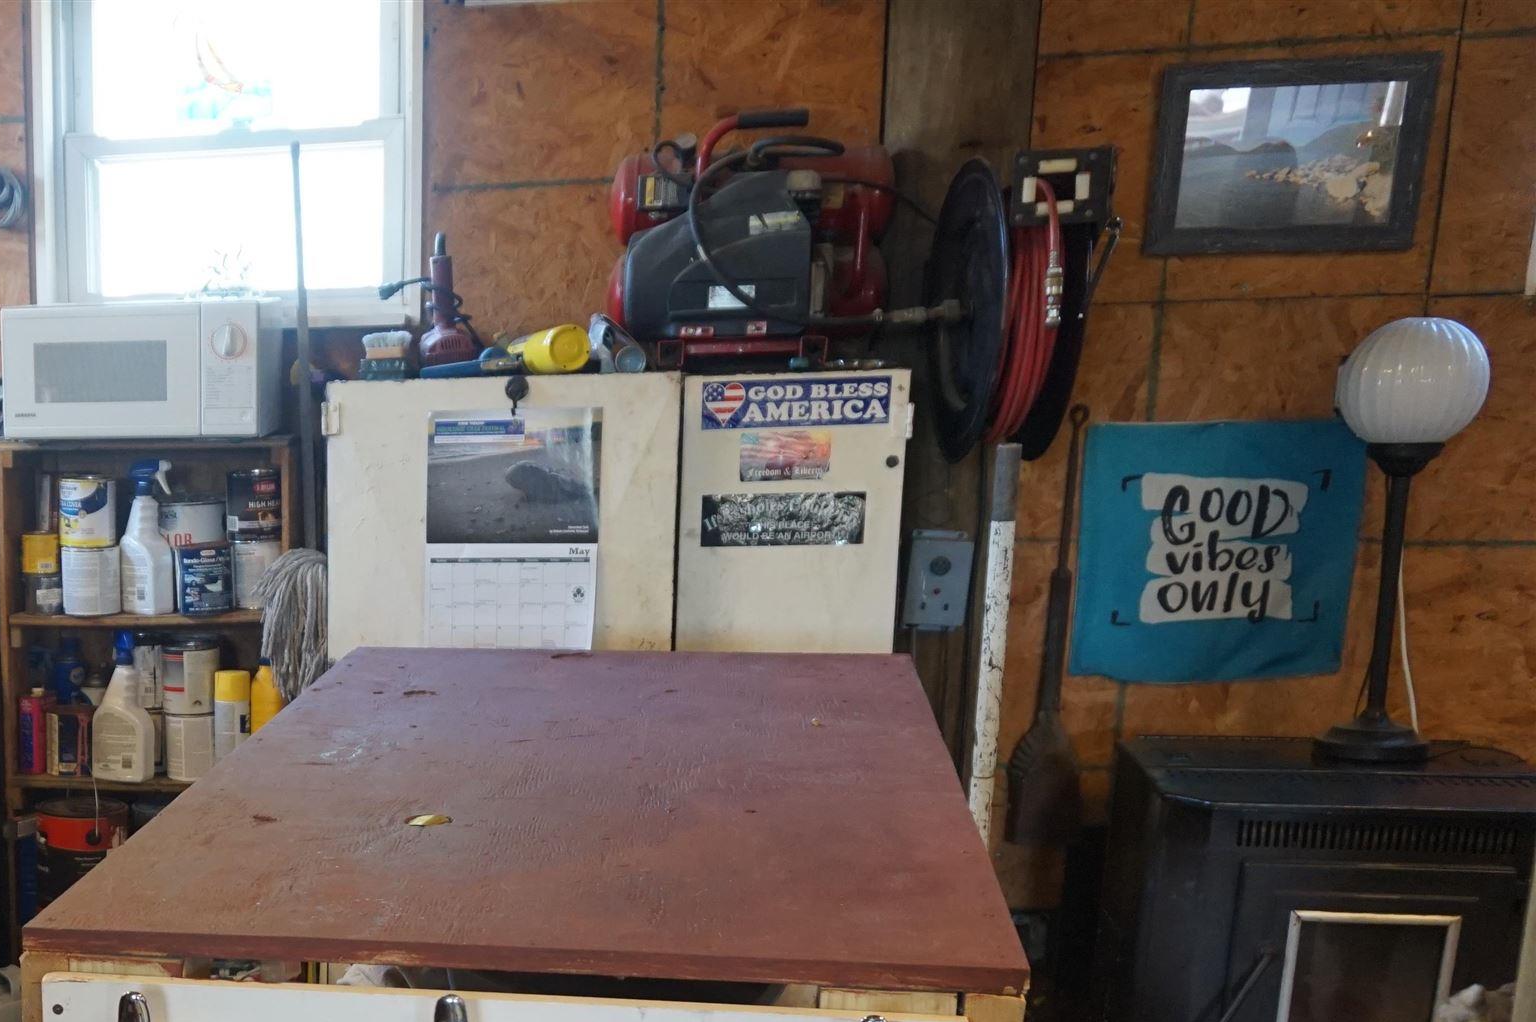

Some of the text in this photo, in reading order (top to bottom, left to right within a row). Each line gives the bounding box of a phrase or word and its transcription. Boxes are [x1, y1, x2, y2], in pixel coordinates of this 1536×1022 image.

[748, 381, 889, 400] GOD BLESS
[742, 399, 886, 422] AMERICA
[1161, 484, 1291, 545] GOOD
[724, 530, 835, 541] WOULD BE AN AIRPOR
[569, 547, 591, 557] May
[1165, 530, 1281, 574] vibes
[1157, 571, 1270, 623] only
